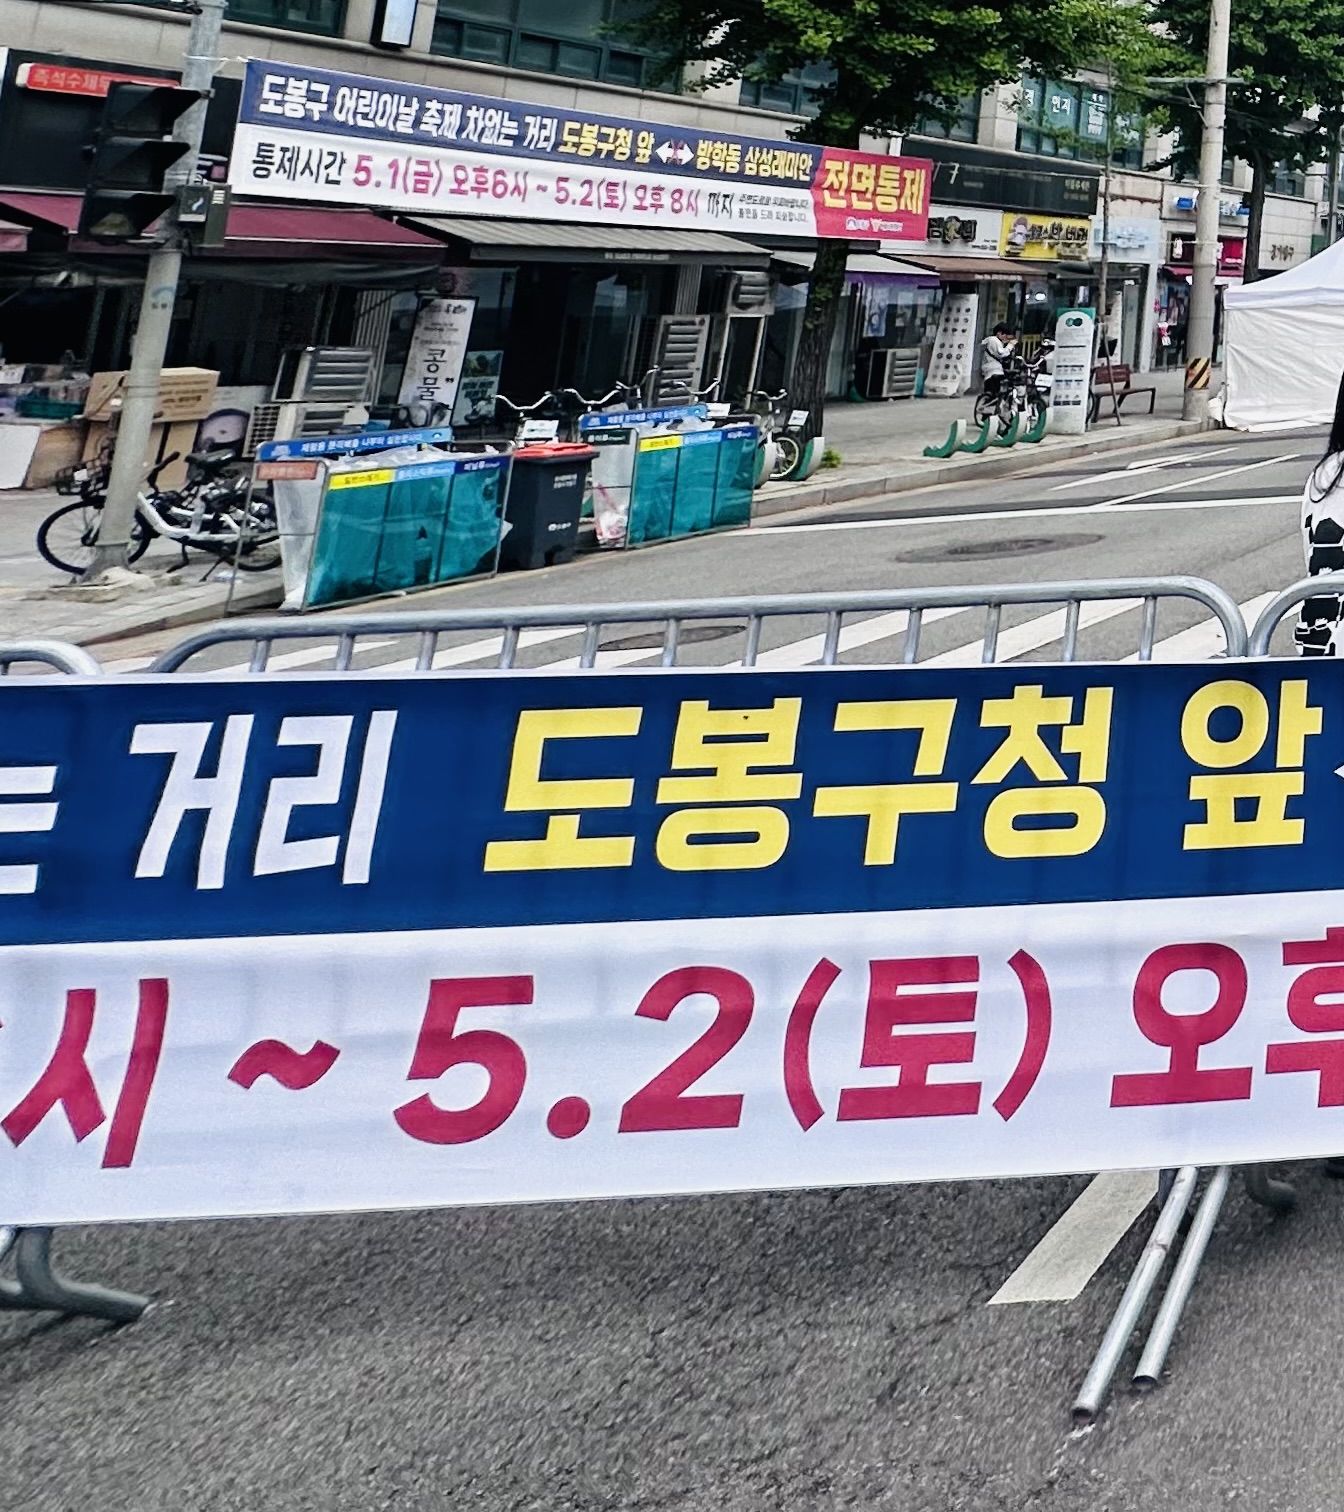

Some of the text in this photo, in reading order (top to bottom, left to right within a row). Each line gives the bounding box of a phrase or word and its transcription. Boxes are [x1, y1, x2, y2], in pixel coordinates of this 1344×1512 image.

[251, 141, 347, 186] 통제시간
[352, 155, 443, 197] 5.1(금)
[448, 164, 529, 203] 오후6시
[554, 176, 628, 213] 5.2(토)
[632, 183, 665, 215] 오후
[671, 187, 699, 217] 8시
[707, 191, 734, 220] 까지
[259, 74, 331, 122] 도봉구
[333, 87, 419, 134] 어린이날
[419, 99, 462, 140] 축제
[462, 105, 519, 146] 차없는
[523, 114, 558, 153] 거리
[558, 120, 634, 162] 도봉구청
[635, 132, 656, 165] 앞
[696, 139, 742, 175] 방학동
[745, 145, 813, 182] 삼성래미안
[822, 159, 926, 215] 전면통제
[128, 710, 399, 890] 거리
[482, 684, 1114, 873] 도봉구청
[1180, 678, 1324, 851] 앞
[393, 945, 1052, 1146] 5.2(토)
